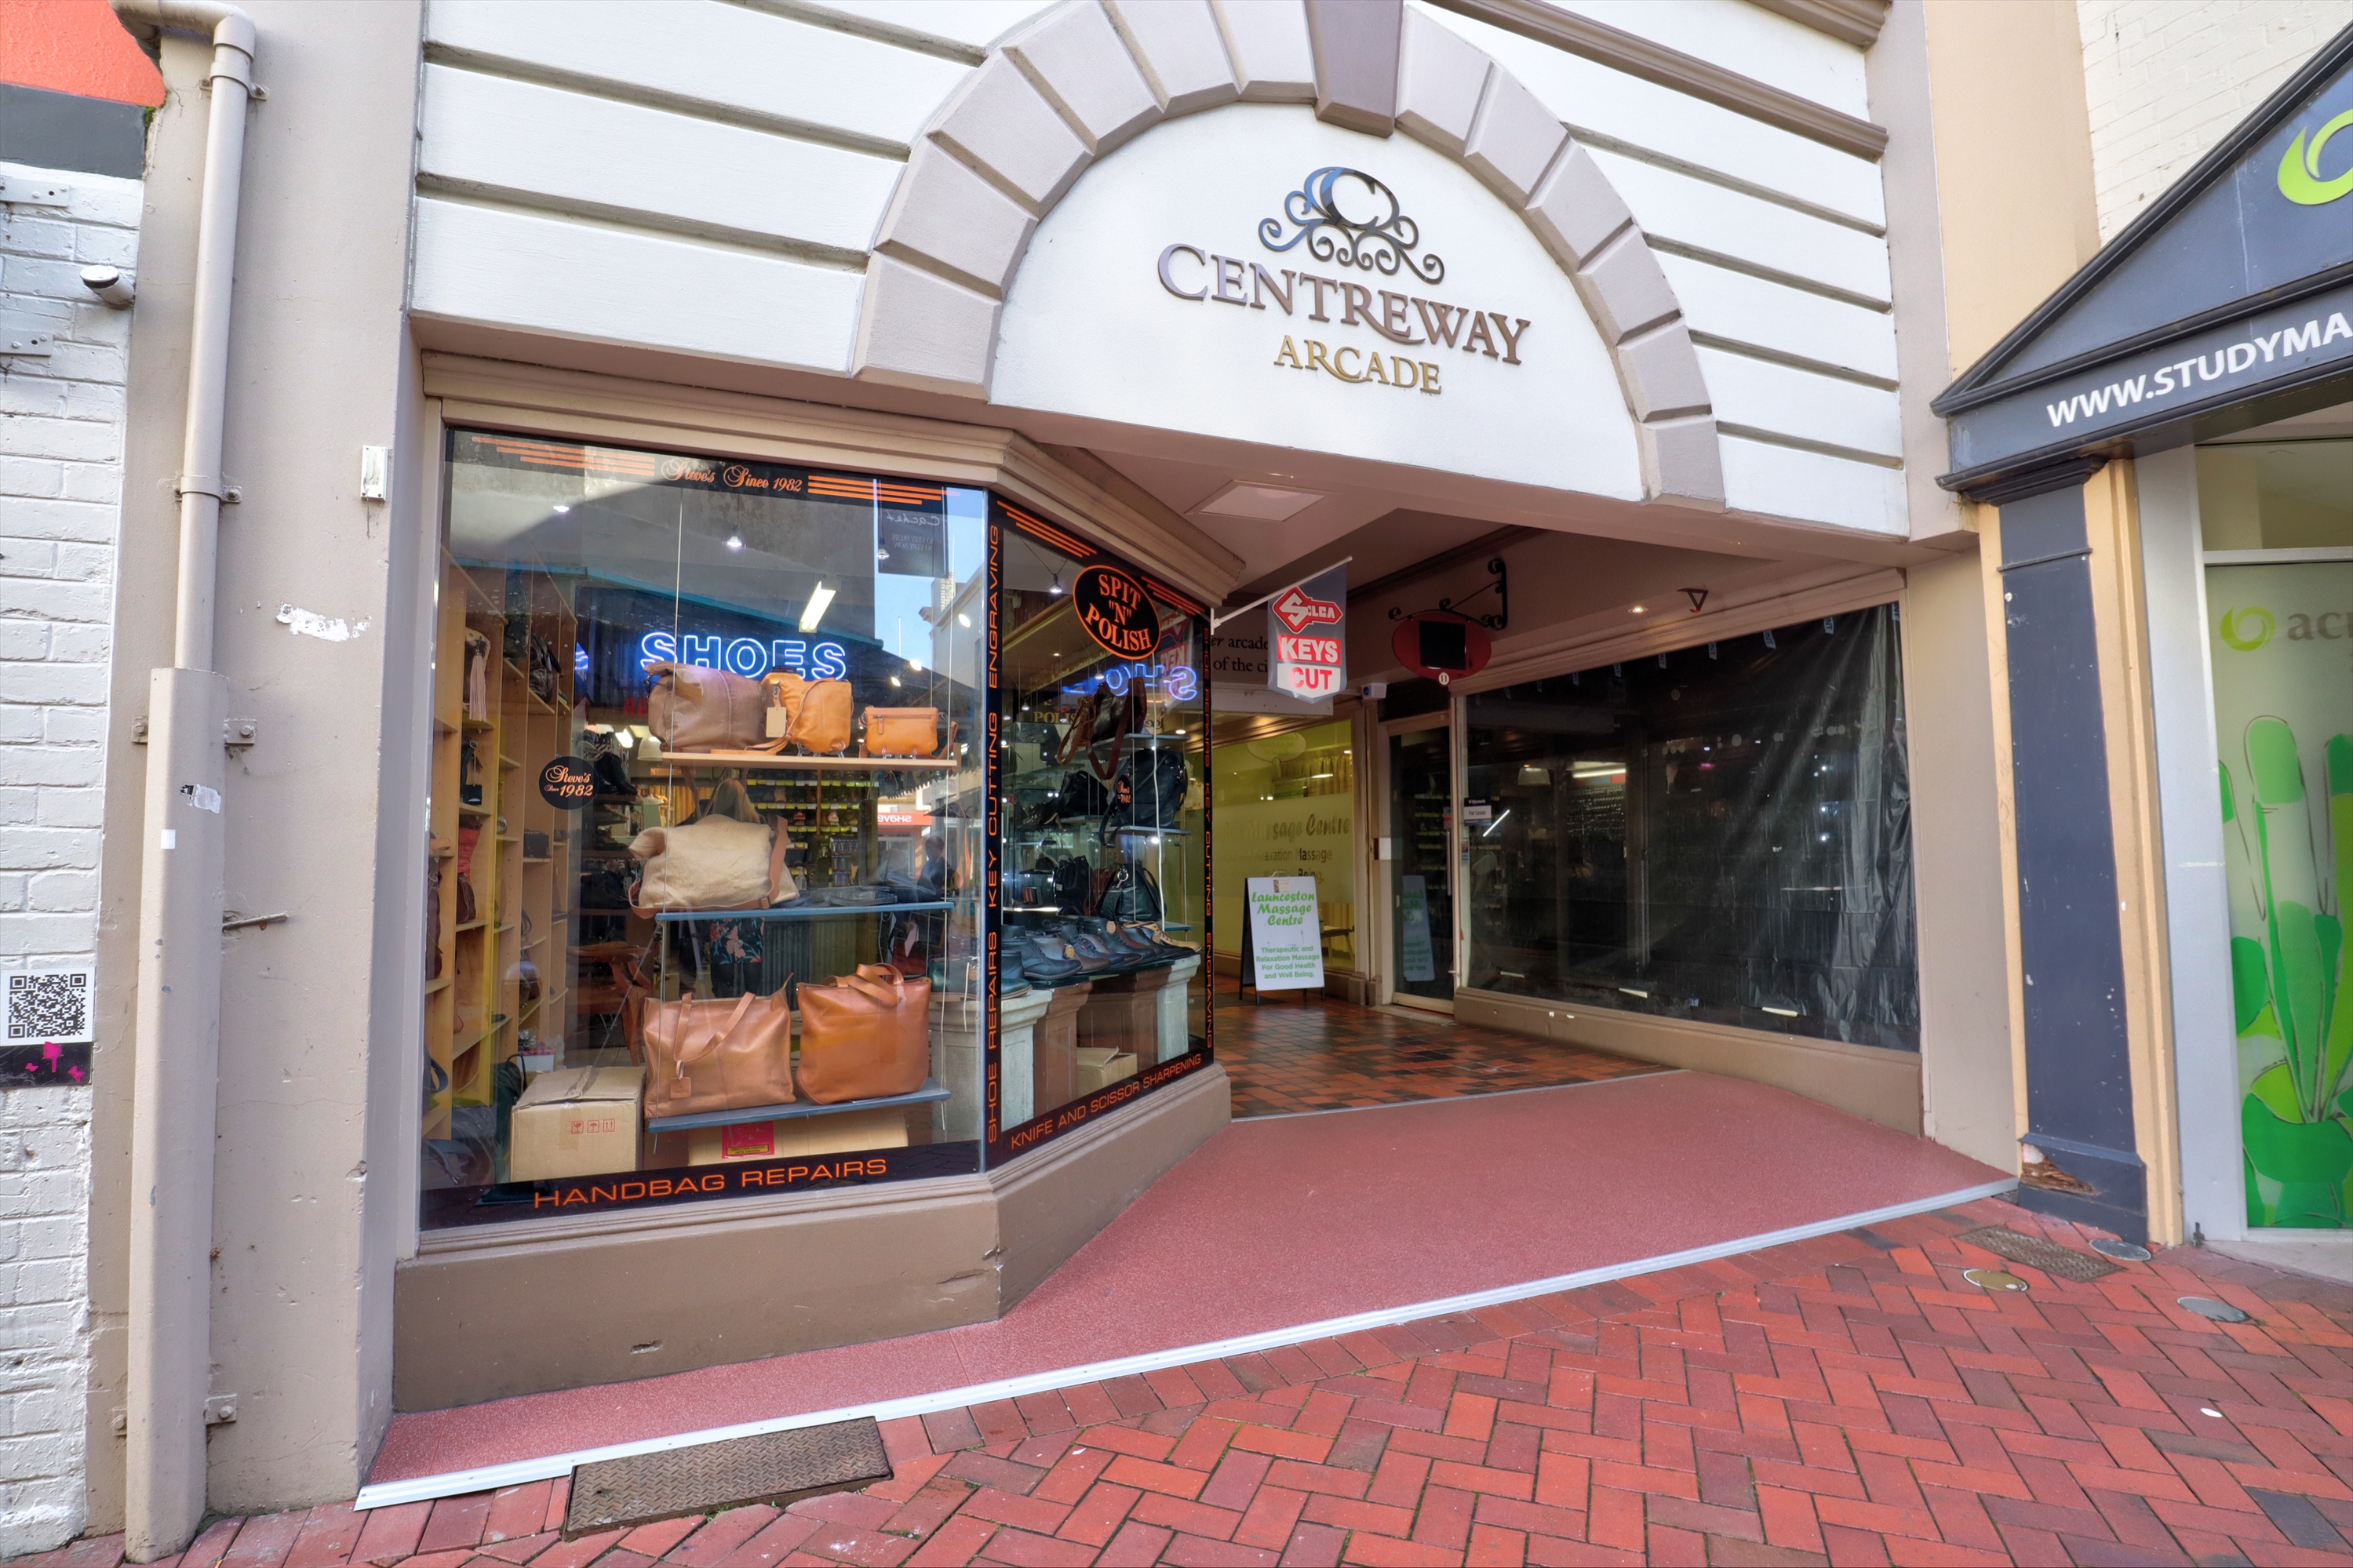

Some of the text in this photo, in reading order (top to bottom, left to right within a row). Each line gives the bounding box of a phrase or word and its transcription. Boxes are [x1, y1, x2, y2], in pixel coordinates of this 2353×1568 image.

[1158, 243, 1530, 365] CENTREWAY
[1274, 334, 1442, 395] ARCADE
[661, 457, 803, 493] Steve's Since 1982
[1098, 573, 1142, 610] SPIT
[1085, 602, 1152, 652] POLISH
[640, 631, 847, 680] SHOES
[1213, 657, 1229, 671] of
[1232, 657, 1253, 672] the
[1280, 637, 1339, 663] KEYS
[1289, 667, 1332, 690] CUT
[545, 765, 591, 783] Steve's
[559, 784, 594, 798] 1982
[988, 525, 1000, 1144] SHOE REPAIRS KEY CUTTING ENGRAVING
[1251, 890, 1315, 902] Launceston
[1257, 903, 1312, 915] Massage
[1267, 915, 1303, 926] Centre
[1011, 1053, 1201, 1149] KNIFE AND SCISSOR SHARPENING
[534, 1159, 887, 1209] HANDBAG REPAIRS
